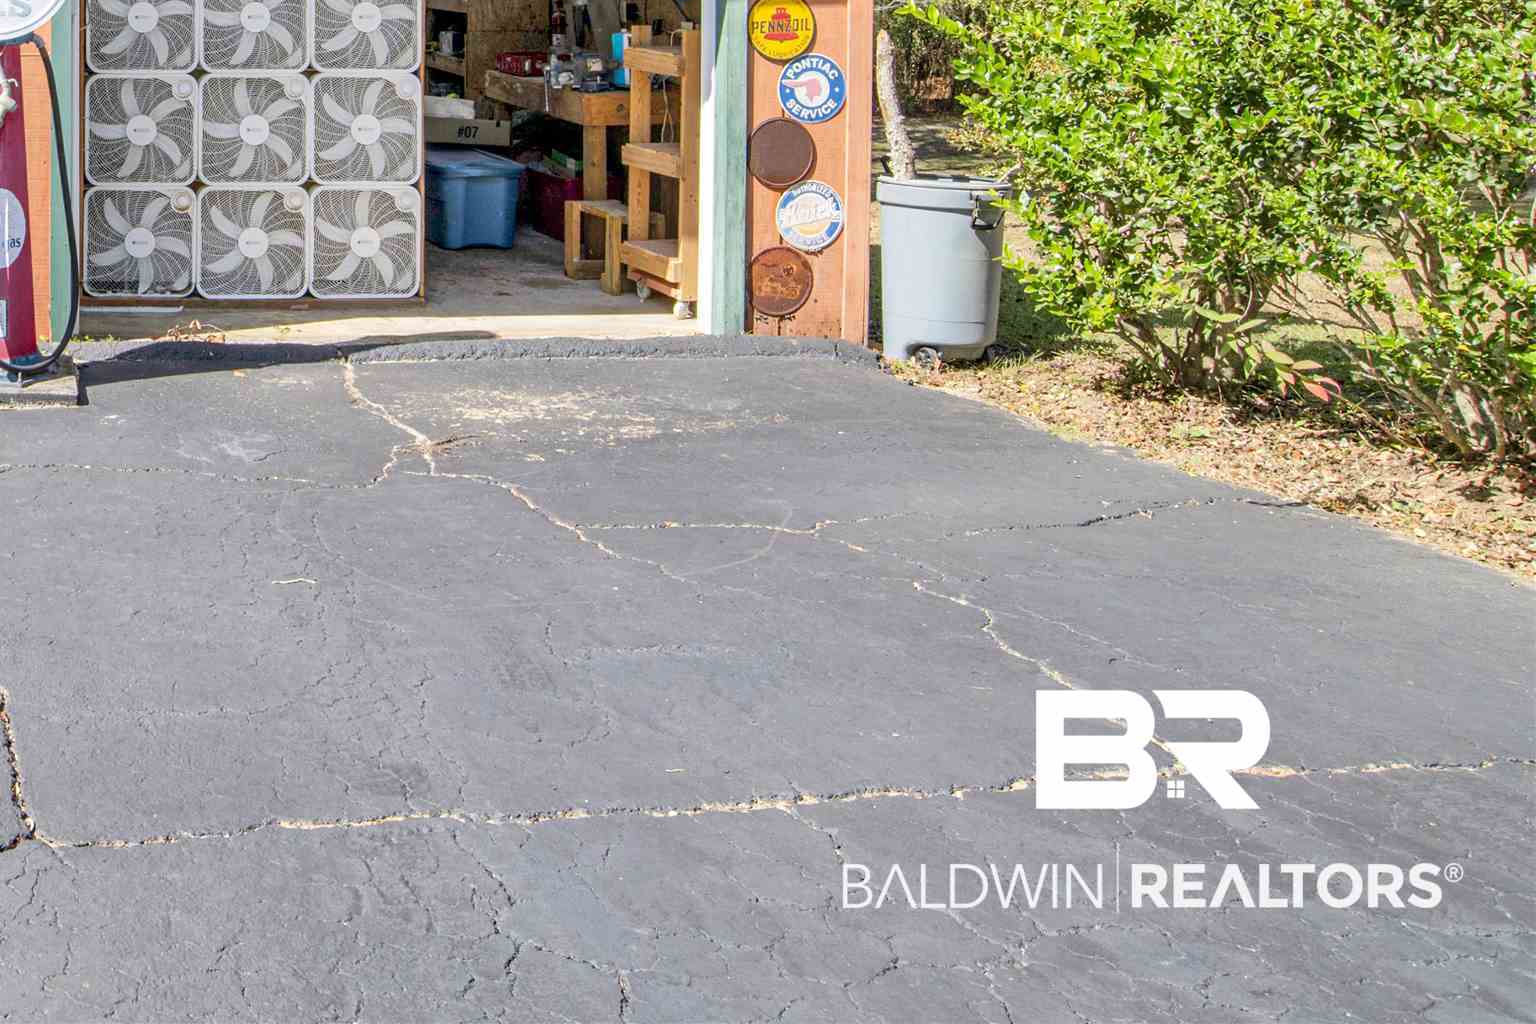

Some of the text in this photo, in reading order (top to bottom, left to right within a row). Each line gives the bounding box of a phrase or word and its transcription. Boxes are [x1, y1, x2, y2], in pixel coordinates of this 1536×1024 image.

[751, 17, 812, 34] PENNZOIL
[787, 57, 840, 81] PONTIAC
[785, 99, 838, 119] SERVICE
[458, 126, 479, 138] #07
